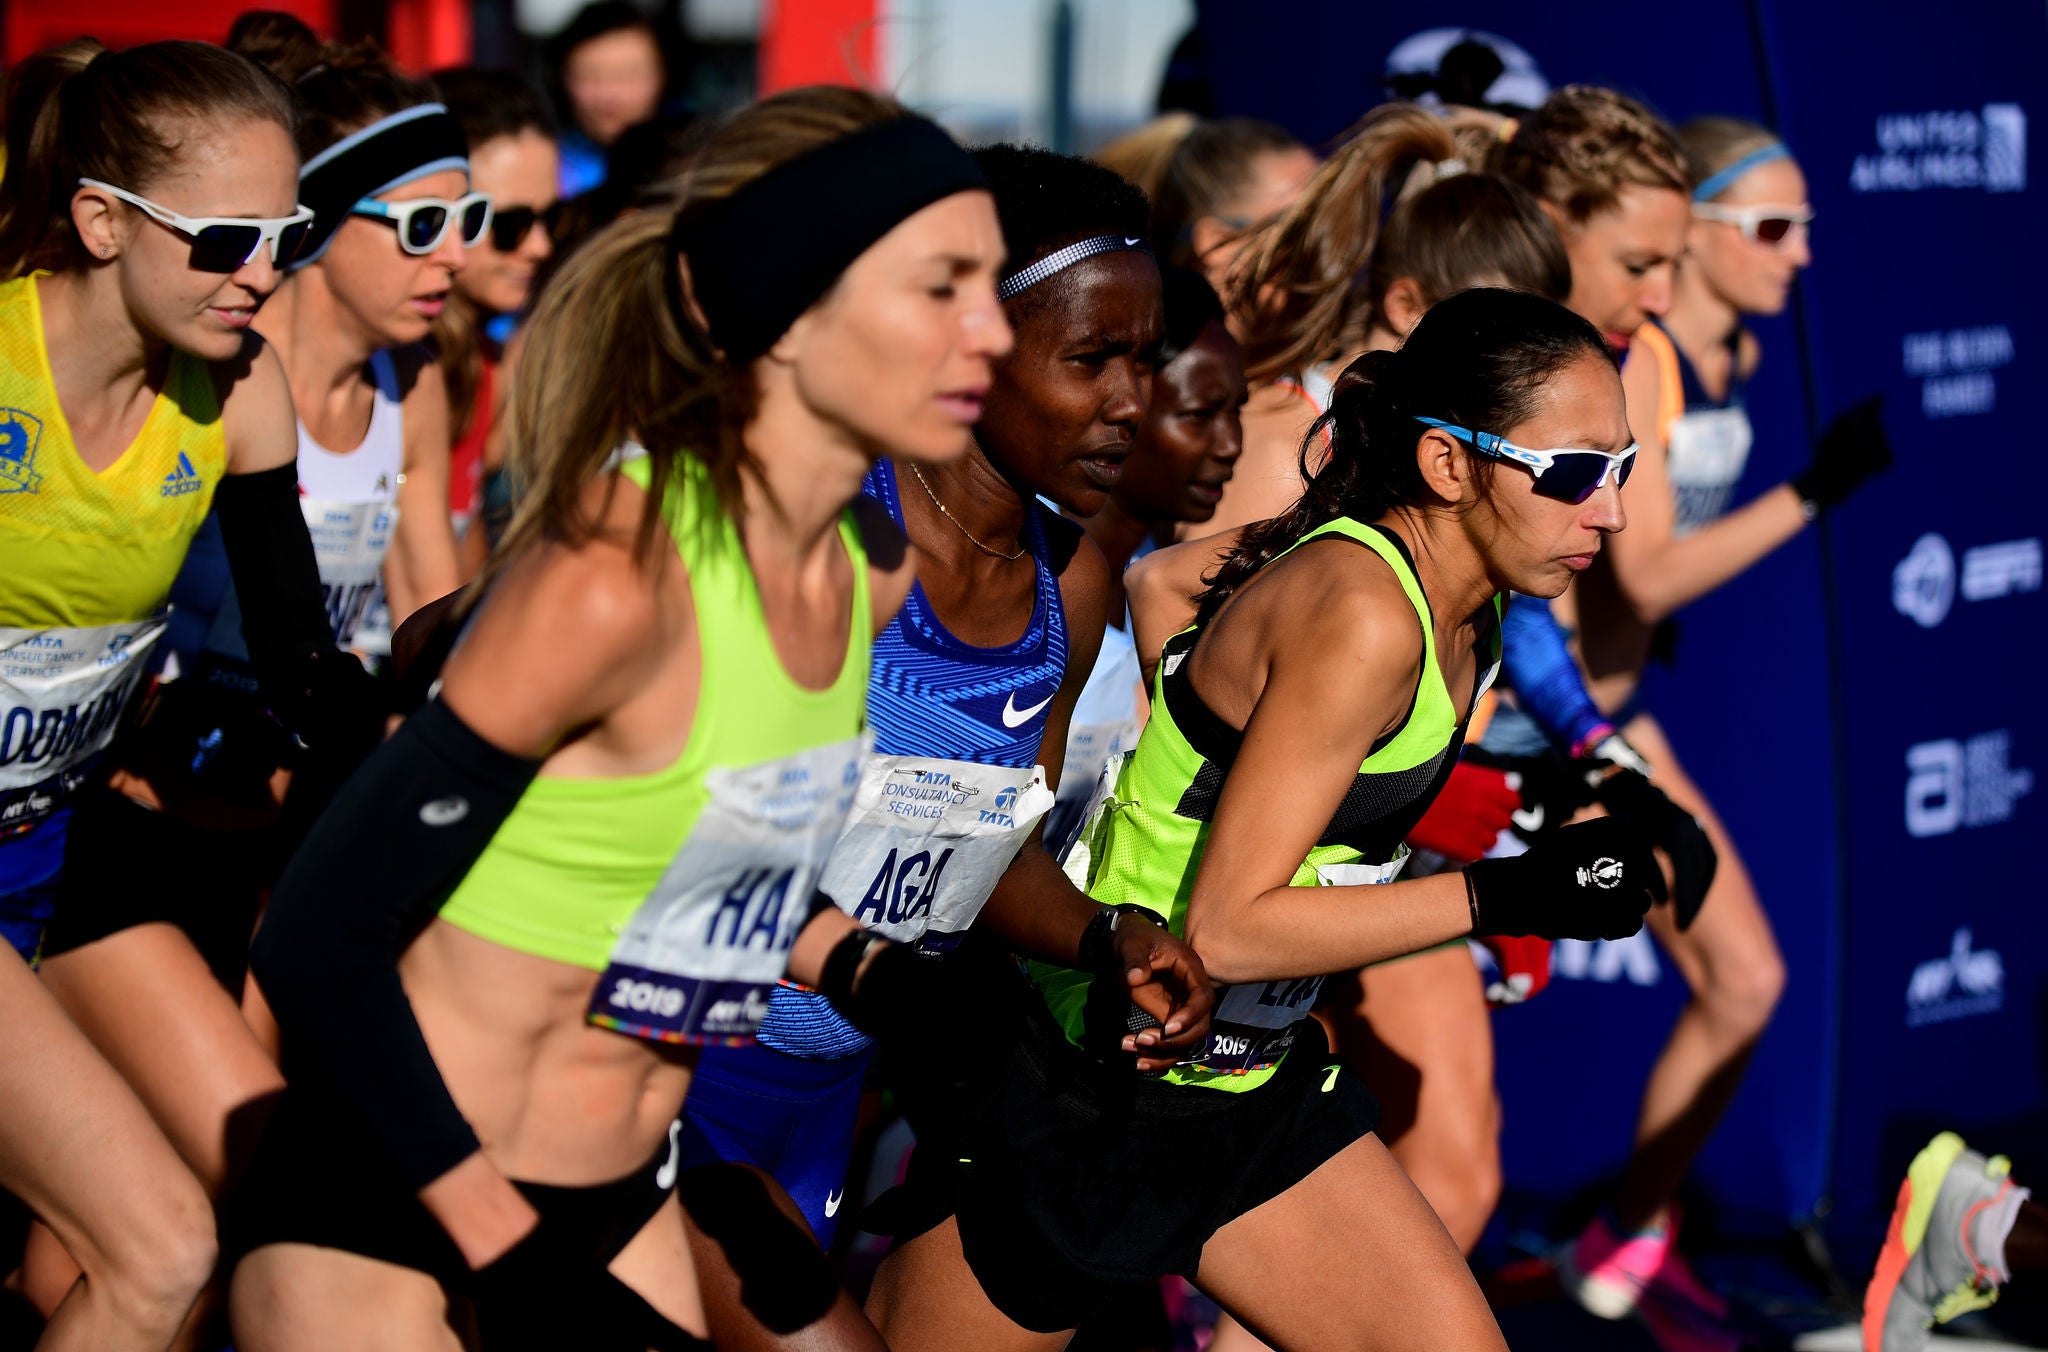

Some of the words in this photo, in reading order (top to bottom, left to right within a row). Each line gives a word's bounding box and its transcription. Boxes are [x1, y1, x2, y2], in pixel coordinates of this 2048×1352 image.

[160, 480, 202, 498] adidas
[915, 771, 952, 786] TATA
[881, 782, 971, 806] CONSULTANCY
[887, 800, 945, 819] SERVICES
[978, 809, 1015, 829] TATA
[852, 847, 955, 925] AGA
[707, 866, 797, 951] HA
[609, 977, 686, 1018] 2019
[1212, 1034, 1251, 1056] 2019
